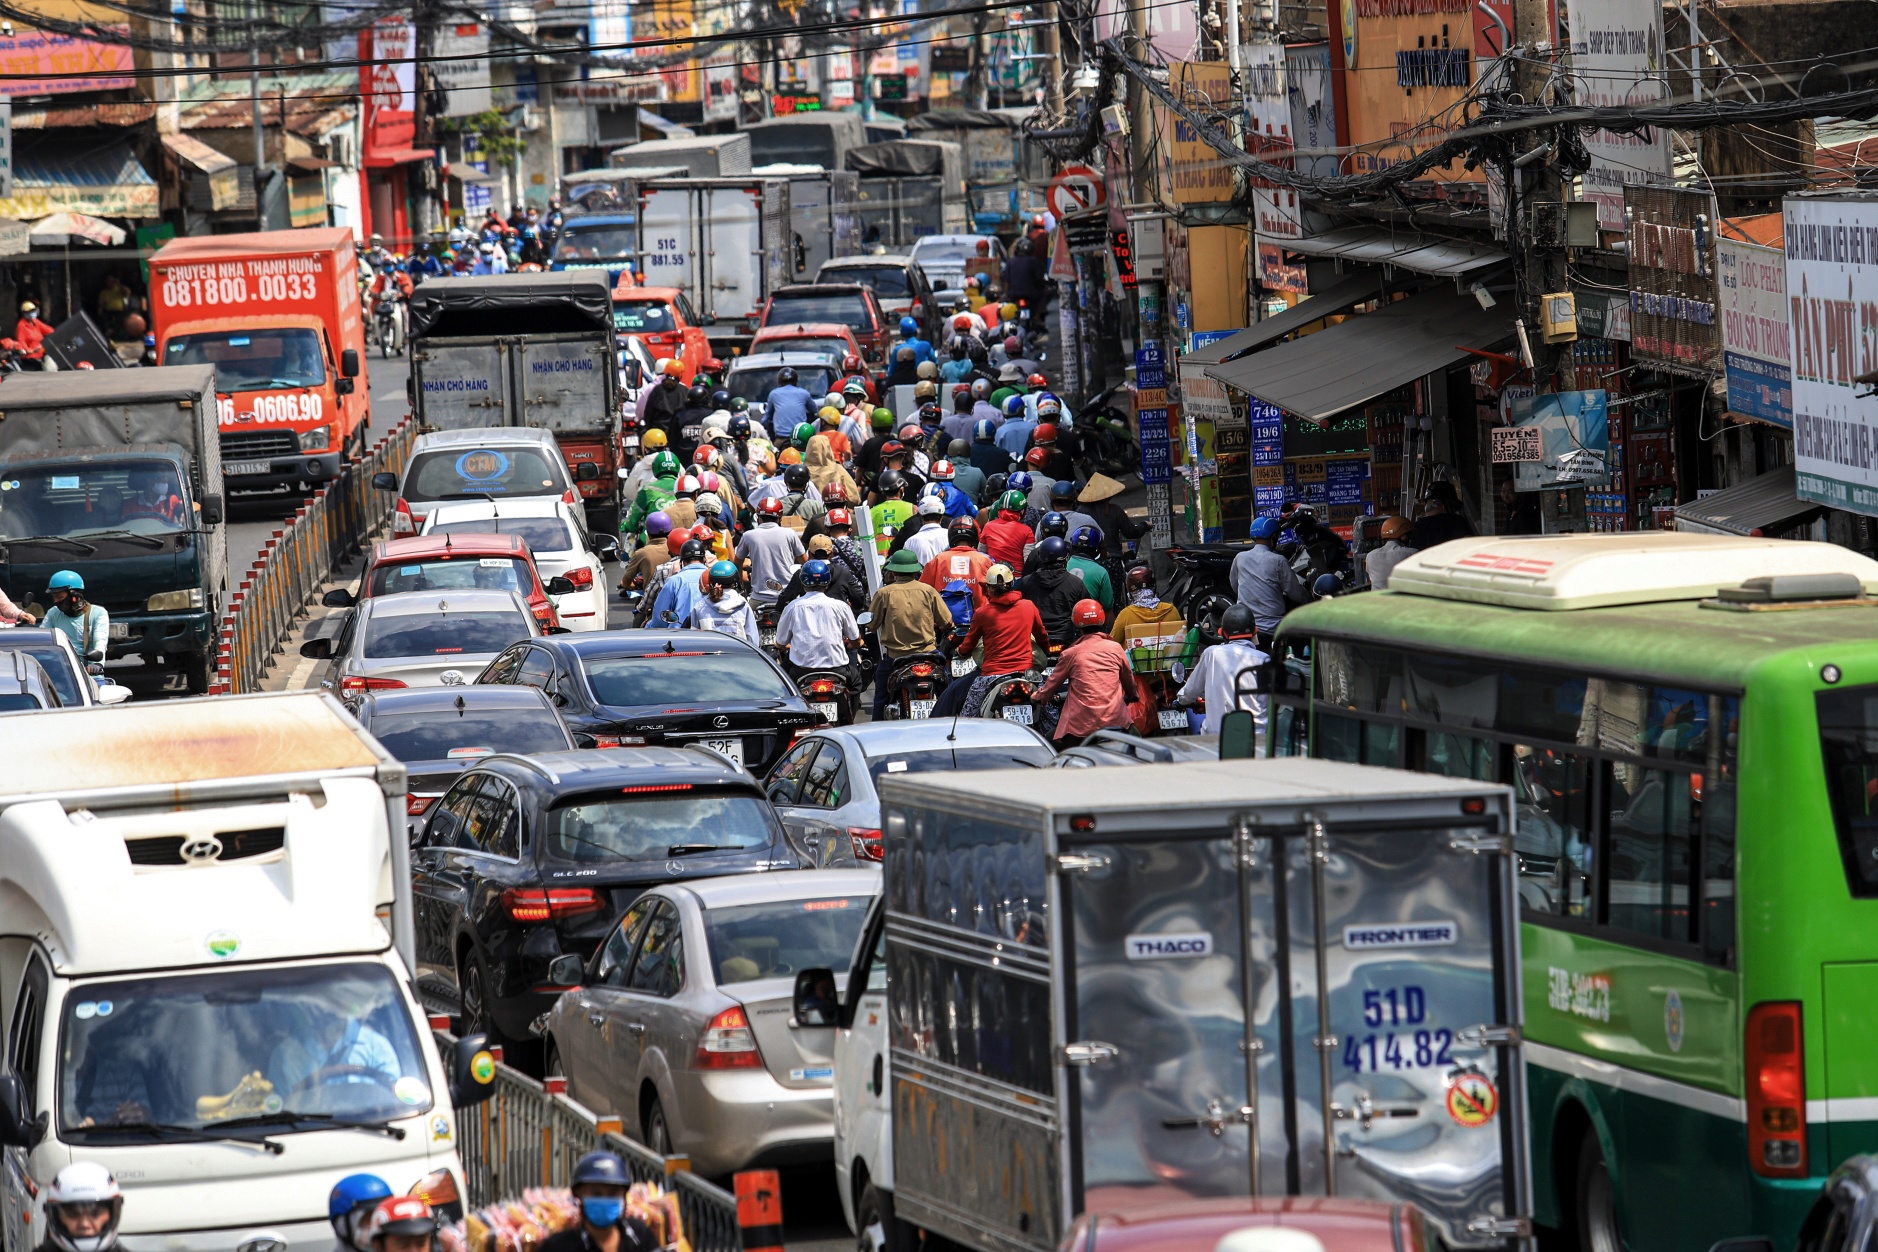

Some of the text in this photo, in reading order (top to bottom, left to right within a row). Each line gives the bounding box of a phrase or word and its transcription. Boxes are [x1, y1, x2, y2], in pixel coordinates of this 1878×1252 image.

[1590, 30, 1602, 54] SHOP
[1603, 25, 1614, 54] DÉP
[1628, 29, 1646, 54] TRANG
[657, 238, 676, 252] 51C
[1800, 215, 1818, 261] HÀNG
[1740, 255, 1758, 294] LỘC
[1760, 258, 1783, 294] PHÁT
[1726, 291, 1743, 349] ĐỔI
[1745, 300, 1758, 352] SỐ
[1790, 271, 1824, 384] TÂN
[1824, 273, 1857, 390] PHÚ
[1142, 350, 1159, 361] 42
[253, 392, 322, 424] 0606.90
[1253, 405, 1279, 419] 746
[1256, 426, 1279, 439] 19/6
[1493, 428, 1532, 442] TUYỂN
[1146, 447, 1167, 458] 226
[661, 461, 677, 469] Grab
[1146, 466, 1169, 478] 31/4
[1299, 462, 1323, 475] 83/9
[1348, 927, 1453, 945] FRONTIER
[1133, 939, 1207, 955] THACO
[1363, 986, 1426, 1028] 51D
[1343, 1028, 1456, 1075] 414.82
